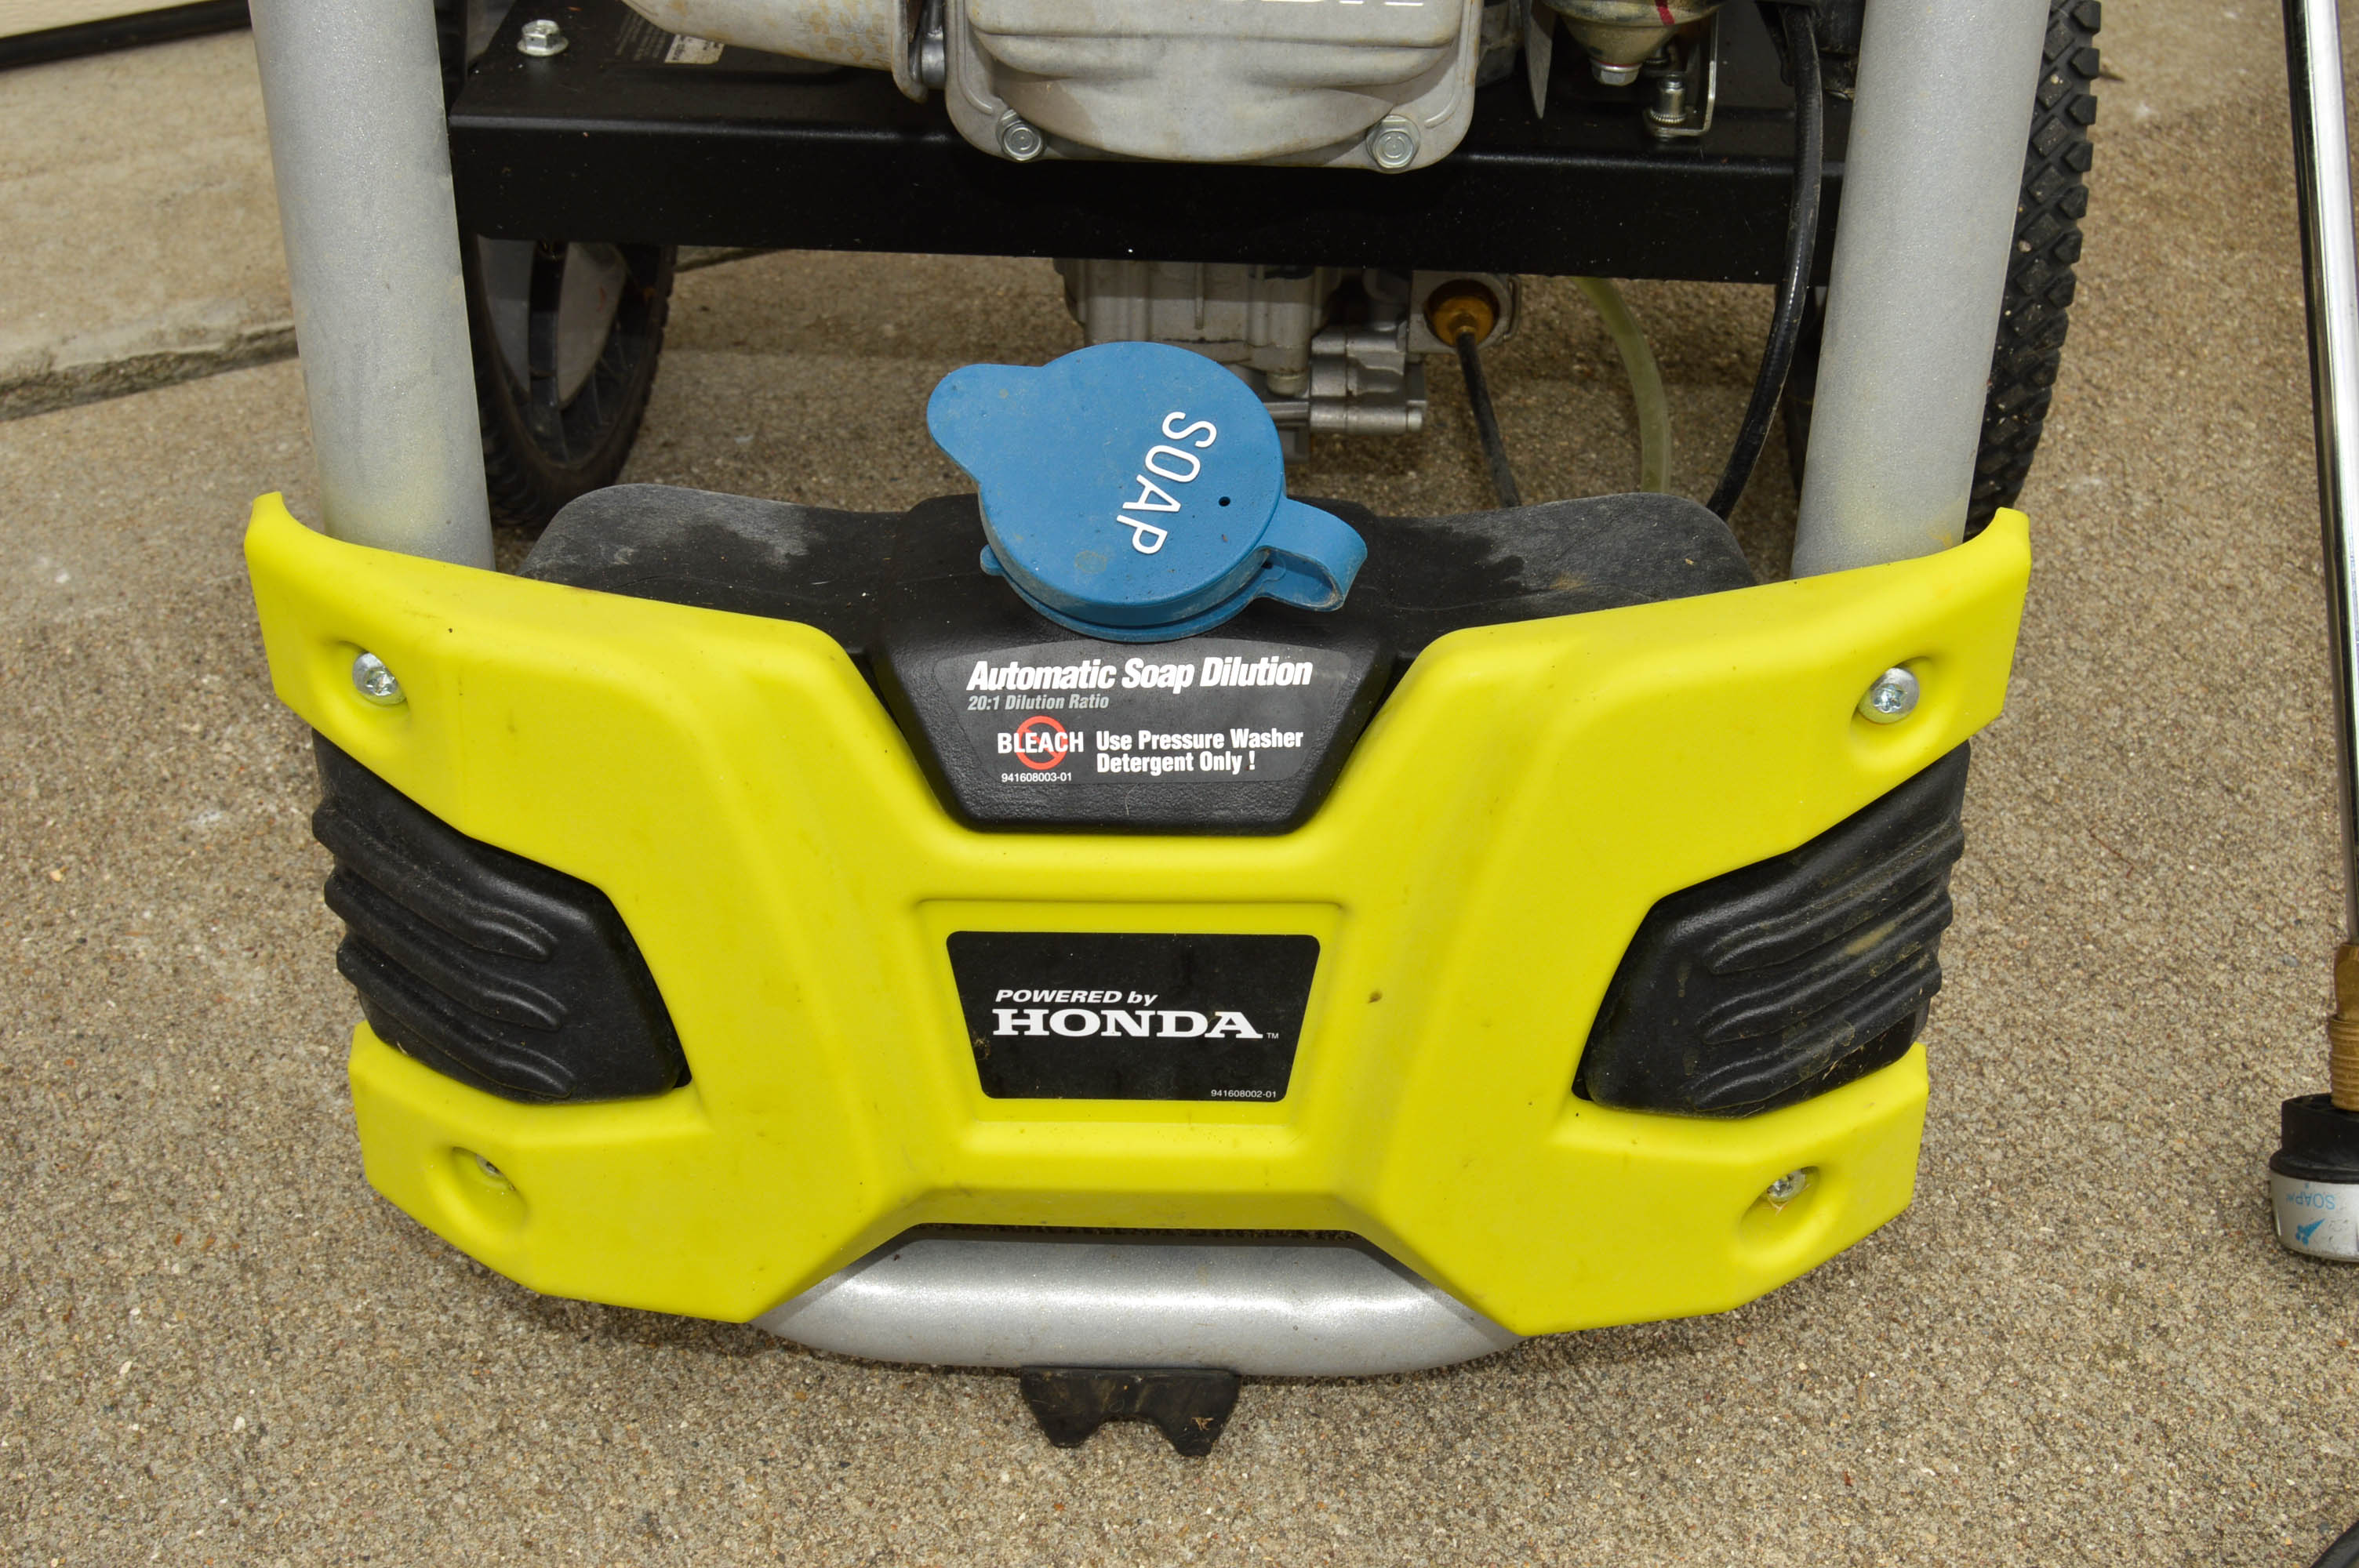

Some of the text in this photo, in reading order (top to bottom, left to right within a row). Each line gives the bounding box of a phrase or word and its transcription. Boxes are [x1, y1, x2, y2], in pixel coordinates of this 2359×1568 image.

[1117, 412, 1217, 554] SOAP
[966, 656, 1314, 694] Automatic Soap Dilution
[967, 693, 1110, 711] 20:1 Dilution Ratio
[998, 731, 1084, 754] BLEACH
[1096, 728, 1303, 751] Use Pressure Washer
[1097, 752, 1194, 776] Detergent
[1200, 751, 1243, 775] Only
[1001, 772, 1072, 783] 941608003-01
[995, 989, 1158, 1007] POWERED by
[992, 1008, 1263, 1039] HONDA
[1211, 1089, 1277, 1098] 941608002-01
